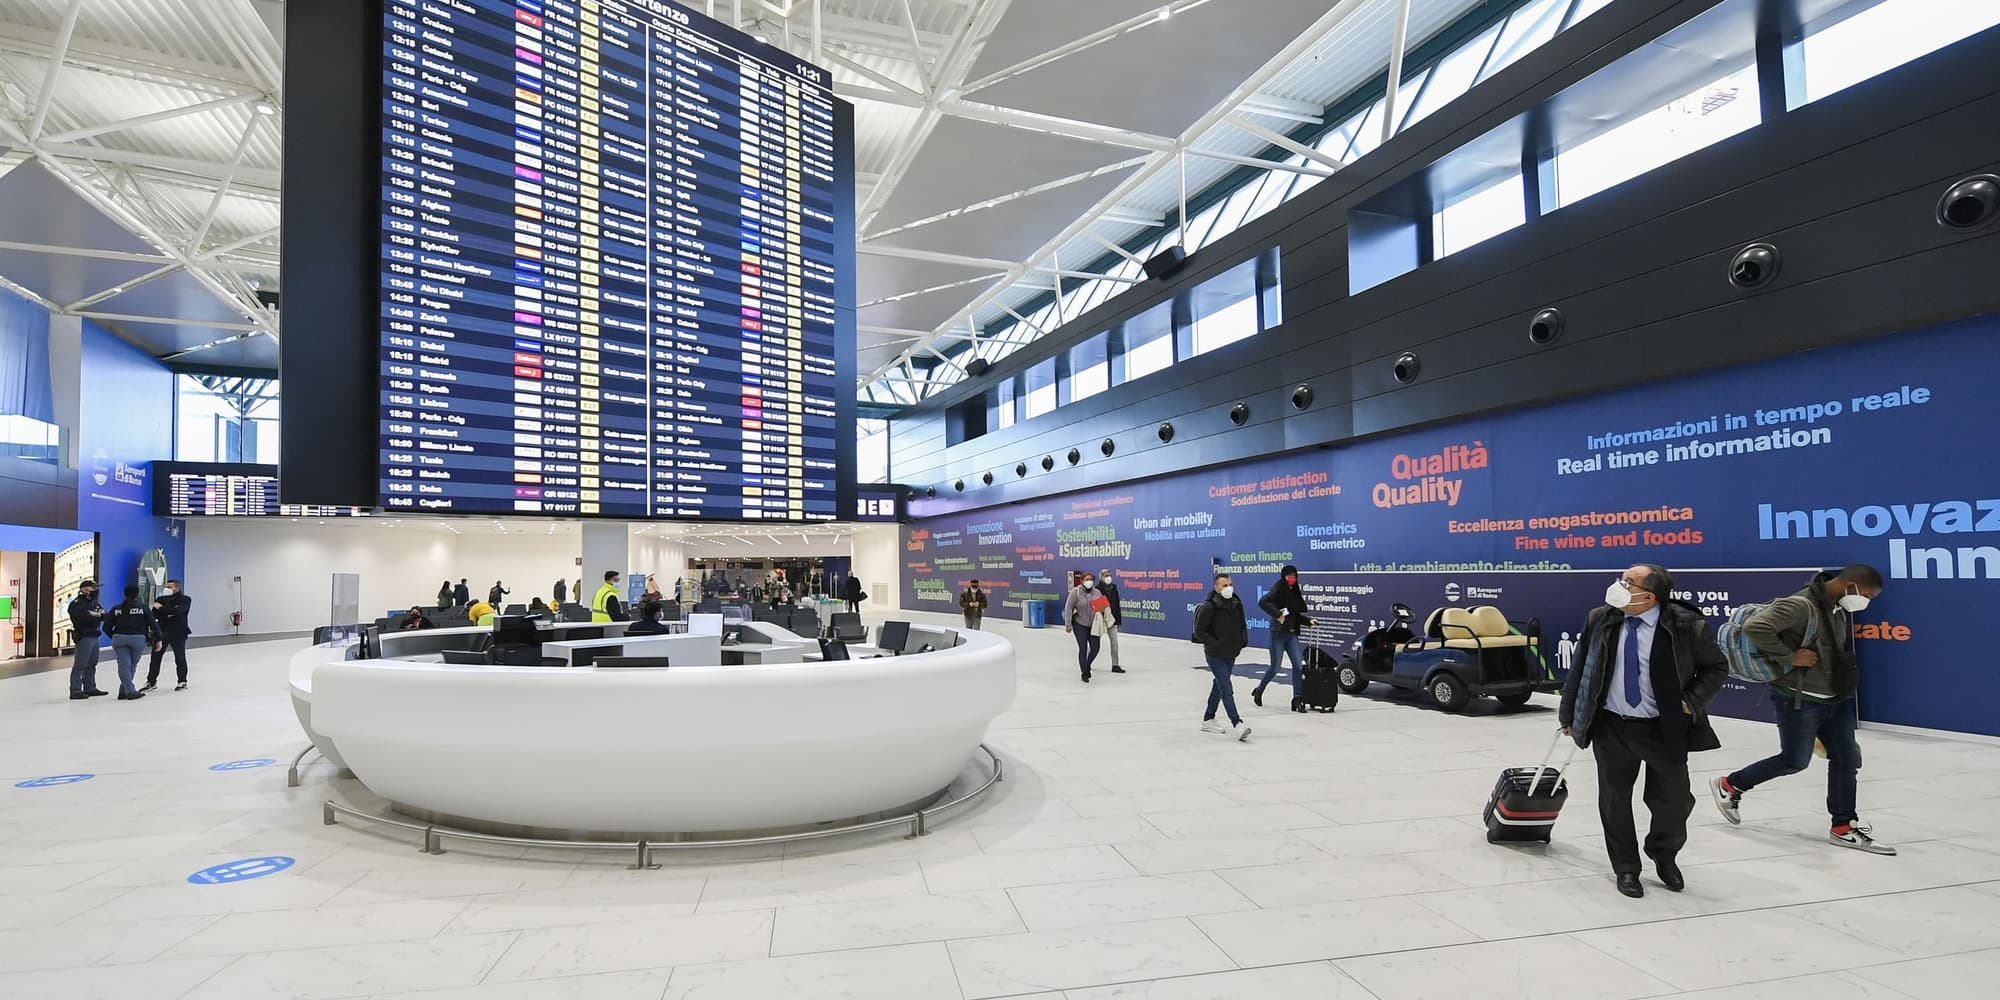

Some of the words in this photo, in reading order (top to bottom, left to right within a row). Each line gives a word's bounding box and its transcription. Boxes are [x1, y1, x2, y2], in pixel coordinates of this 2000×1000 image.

[796, 64, 821, 82] 11:21
[1587, 416, 1718, 450] Informazioni
[1725, 413, 1748, 430] in
[1754, 400, 1842, 429] tempo
[1852, 384, 1931, 413] reale
[1557, 454, 1601, 476] Real
[1608, 447, 1659, 470] time
[1666, 425, 1831, 462] information
[1392, 440, 1488, 480] Qualità
[1209, 482, 1256, 498] Customer
[1260, 472, 1328, 490] satisfaction
[1231, 491, 1289, 507] Soddisfazione
[1292, 490, 1306, 500] del
[1308, 485, 1341, 497] cliente
[1372, 476, 1462, 509] Quality
[869, 502, 878, 515] E
[1134, 517, 1158, 529] Urban
[1160, 516, 1172, 528] air
[1174, 512, 1213, 528] mobility
[1449, 518, 1524, 534] Eccellenza
[1529, 504, 1694, 531] enogastronomica
[967, 520, 1003, 534] Innovazione
[1056, 524, 1116, 543] Sostenibilità
[1145, 530, 1173, 541] Mobilità
[1175, 530, 1195, 540] aerea
[1197, 527, 1226, 538] urbana
[1296, 522, 1357, 537] Biometrics
[978, 532, 1012, 546] Innovation
[1310, 538, 1365, 550] Biometrico
[1515, 535, 1548, 550] Fine
[1554, 533, 1595, 549] wine
[1601, 530, 1637, 548] and
[1642, 528, 1703, 546] foods
[1063, 541, 1131, 560] Sustainability
[1231, 552, 1256, 562] Green
[1258, 550, 1293, 561] finance
[1116, 569, 1147, 580] Passengers
[1149, 570, 1165, 578] come
[1167, 569, 1180, 578] first
[1214, 564, 1242, 573] Finanza
[1244, 563, 1285, 573] sostenibil
[1163, 582, 1182, 591] primo
[1183, 582, 1203, 591] posto
[1336, 585, 1374, 594] passaggio
[1308, 594, 1349, 603] raggiungere
[1696, 592, 1728, 603] you
[1142, 600, 1160, 610] 2030
[1149, 612, 1166, 620] 2030
